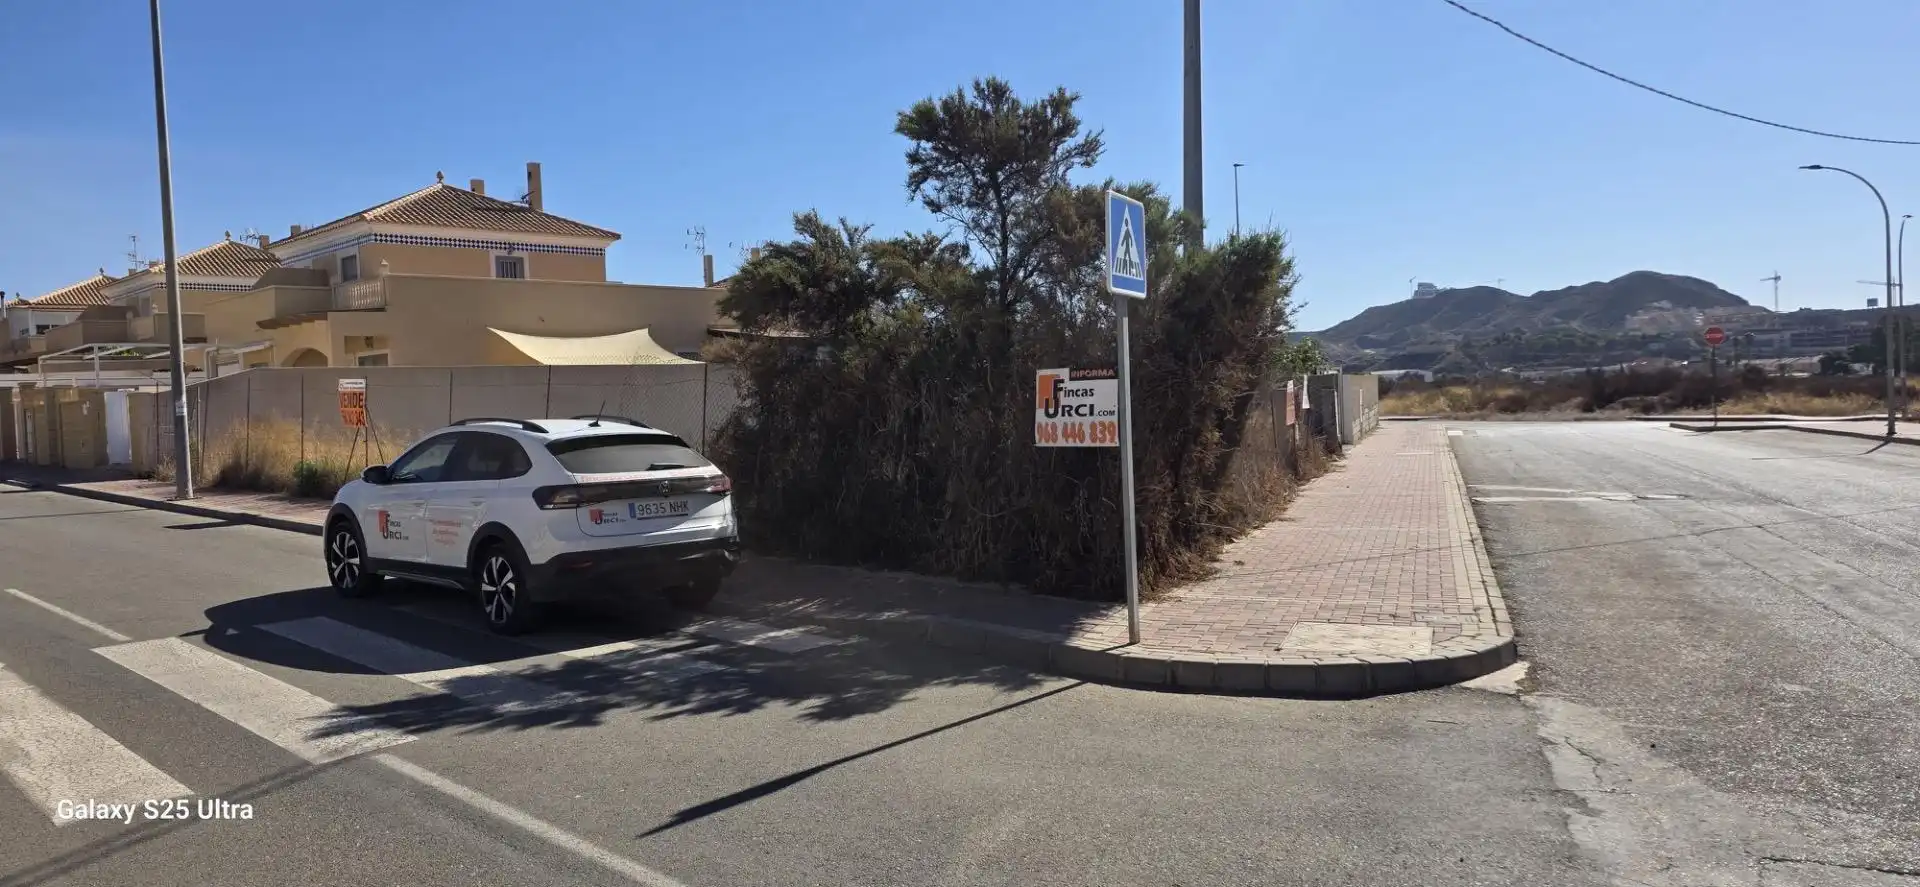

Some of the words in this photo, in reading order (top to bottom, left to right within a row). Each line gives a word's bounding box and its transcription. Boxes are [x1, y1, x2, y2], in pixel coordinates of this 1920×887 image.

[1053, 379, 1095, 399] Fincas
[340, 392, 364, 408] VENDE
[1036, 421, 1058, 443] 968
[1062, 421, 1086, 443] 446
[1089, 421, 1117, 443] 839
